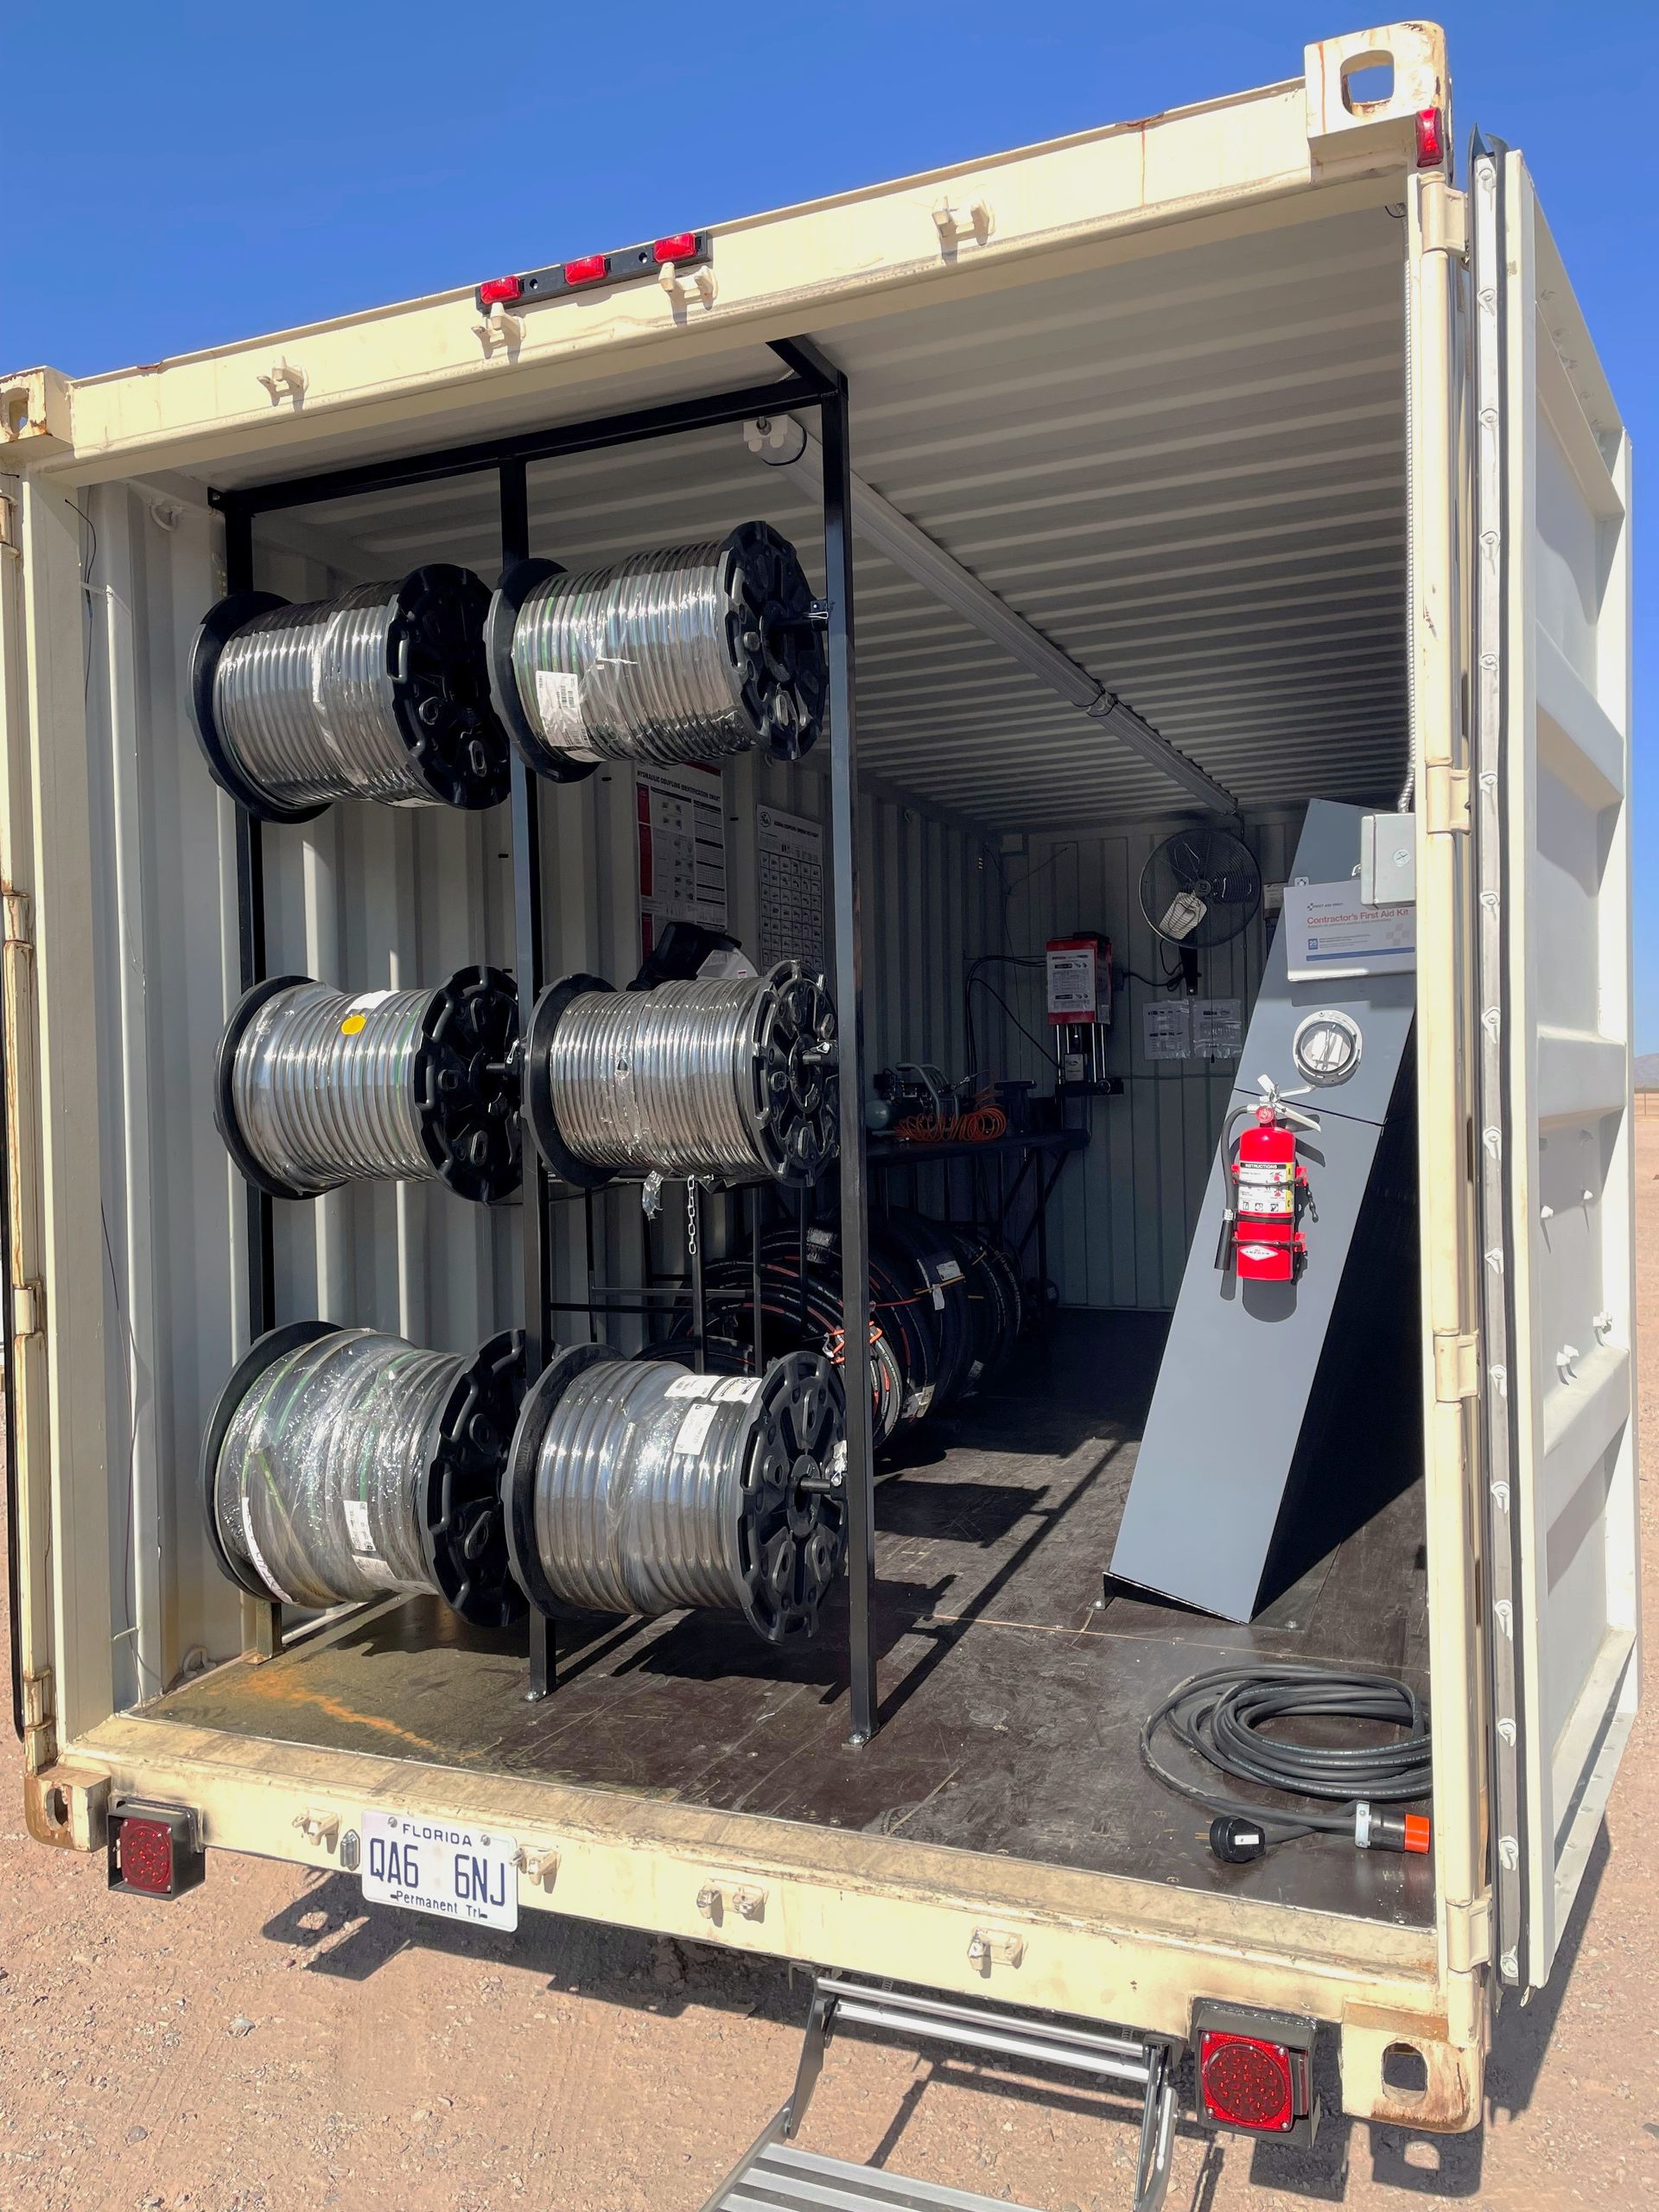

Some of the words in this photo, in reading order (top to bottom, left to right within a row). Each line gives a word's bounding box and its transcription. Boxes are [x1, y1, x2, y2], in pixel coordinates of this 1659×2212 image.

[1307, 913, 1358, 925] Contractor's
[1361, 911, 1378, 919] First
[403, 1823, 473, 1847] FLORIDA
[370, 1837, 419, 1889] QA6
[454, 1853, 505, 1907] 6NJ
[396, 1891, 458, 1914] Permanent
